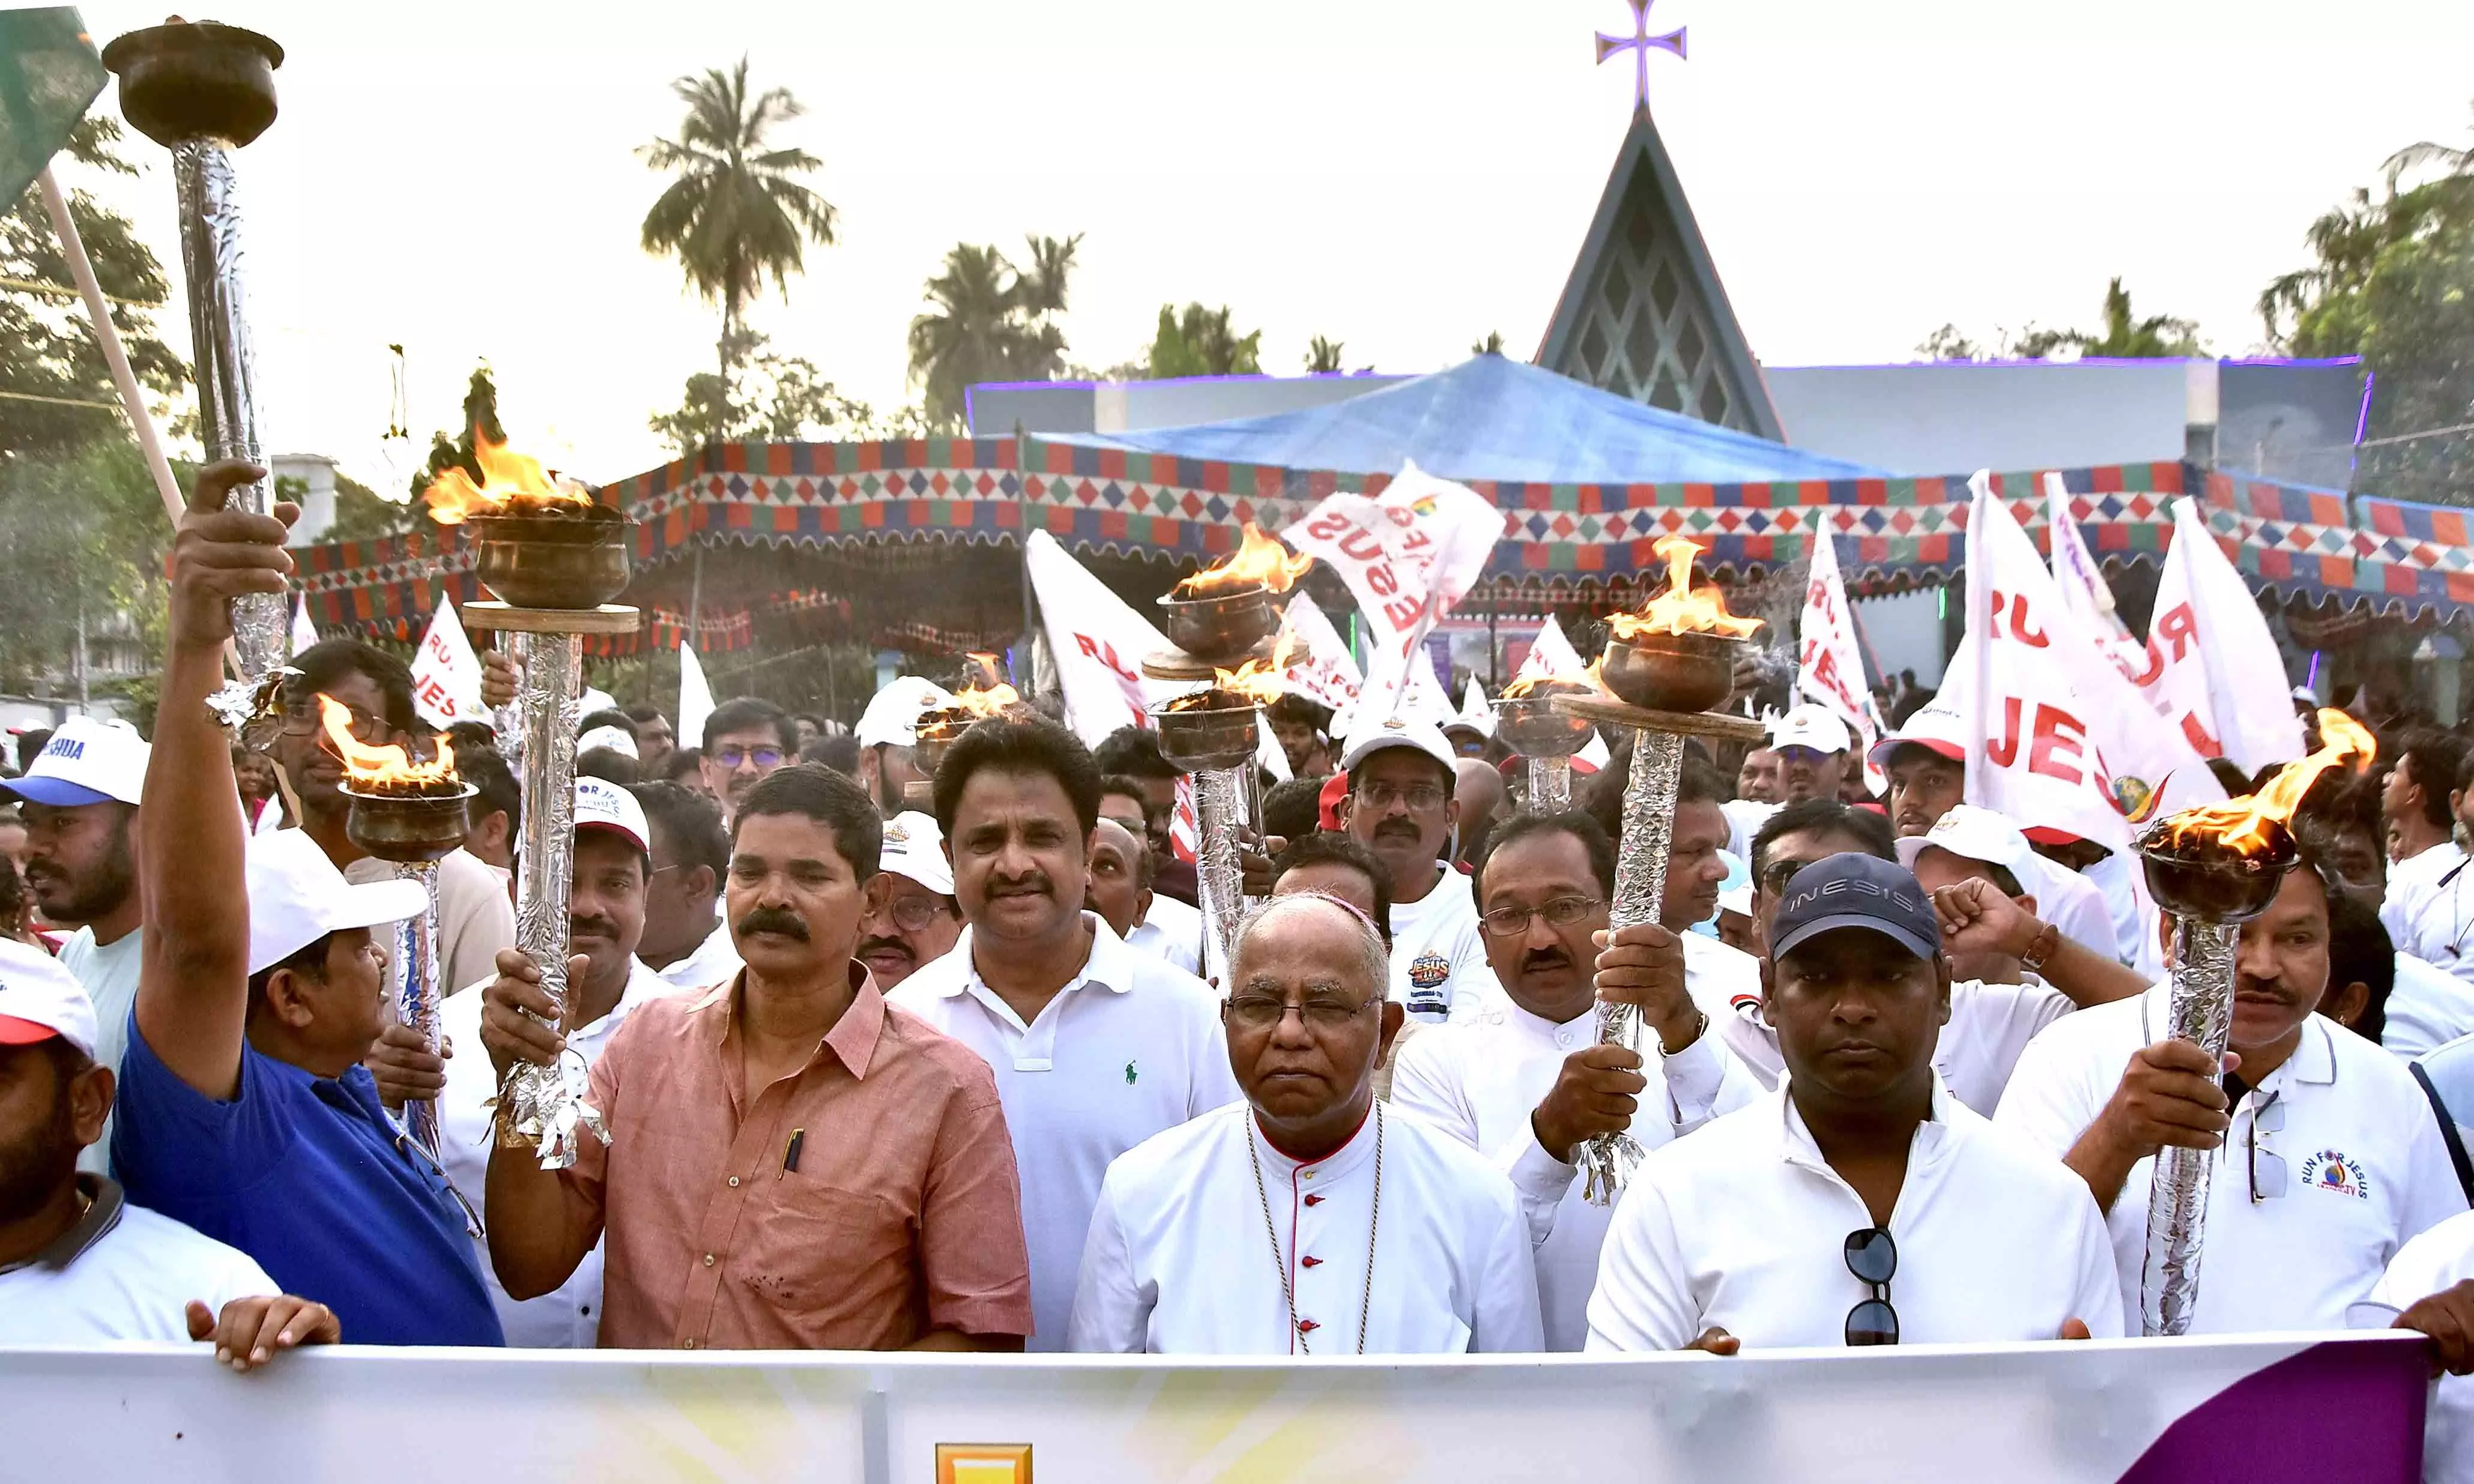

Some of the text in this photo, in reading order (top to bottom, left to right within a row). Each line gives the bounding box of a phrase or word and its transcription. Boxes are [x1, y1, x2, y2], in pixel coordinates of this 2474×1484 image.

[1807, 579, 1839, 639] RU
[428, 633, 453, 671] RU
[1986, 696, 2105, 794] JE
[1789, 878, 1913, 912] INESIS
[1408, 961, 1449, 977] JESUS
[2302, 1158, 2317, 1184] RUN
[2316, 1149, 2344, 1163] FOR
[2345, 1160, 2368, 1199] JESUS
